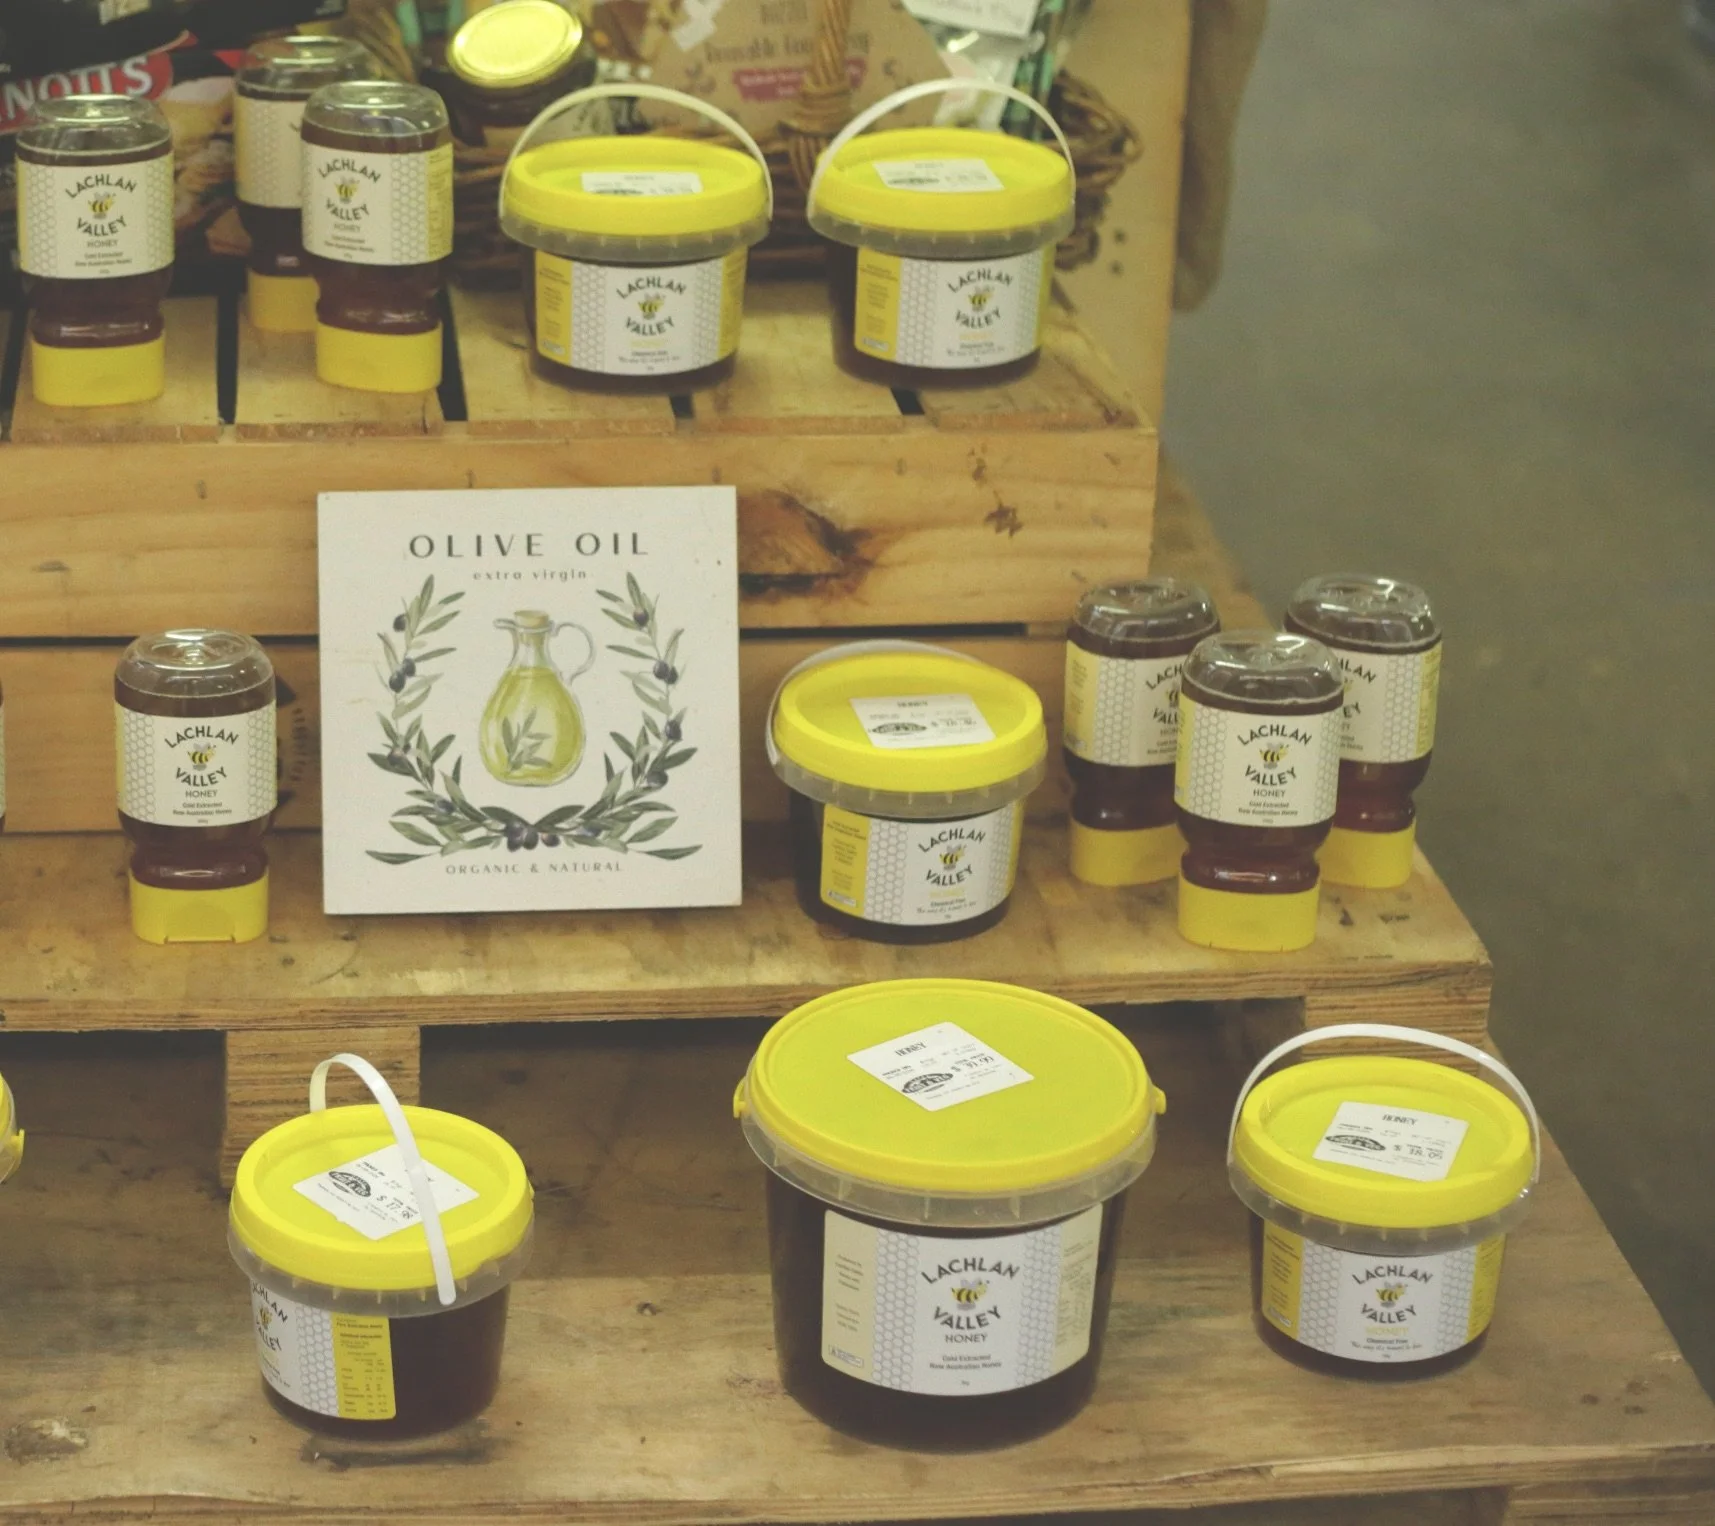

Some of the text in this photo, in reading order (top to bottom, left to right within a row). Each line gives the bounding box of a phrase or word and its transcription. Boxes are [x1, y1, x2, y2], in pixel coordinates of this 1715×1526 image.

[317, 158, 381, 183] LACHLAN
[65, 173, 138, 198] LACHLAN
[326, 198, 370, 221] VALLEY
[77, 216, 127, 237] VALLEY
[616, 276, 687, 299] LACHLAN
[948, 269, 1013, 293] LACHLAN
[625, 316, 675, 336] VALLEY
[955, 308, 1001, 329] VALLEY
[409, 532, 649, 559] OLIVE OIL
[473, 568, 587, 583] extra virgin
[165, 725, 239, 749] LACHLAN
[1237, 724, 1312, 746] LACHLAN
[176, 766, 227, 787] VALLEY
[1245, 764, 1297, 787] VALLEY
[185, 790, 218, 798] HONEY
[1253, 789, 1286, 797] HONEY
[918, 828, 986, 852] LACHLAN
[445, 861, 623, 875] ORGANIC & NATURAL
[926, 863, 973, 886] VALLEY
[895, 1041, 927, 1057] HONEY
[1382, 1114, 1418, 1126] HONEY
[921, 1257, 1020, 1284] LACHLAN
[1351, 1265, 1433, 1285] LACHLAN
[934, 1305, 1001, 1330] VALLEY
[1360, 1304, 1417, 1324] VALLEY
[945, 1334, 987, 1343] HONEY
